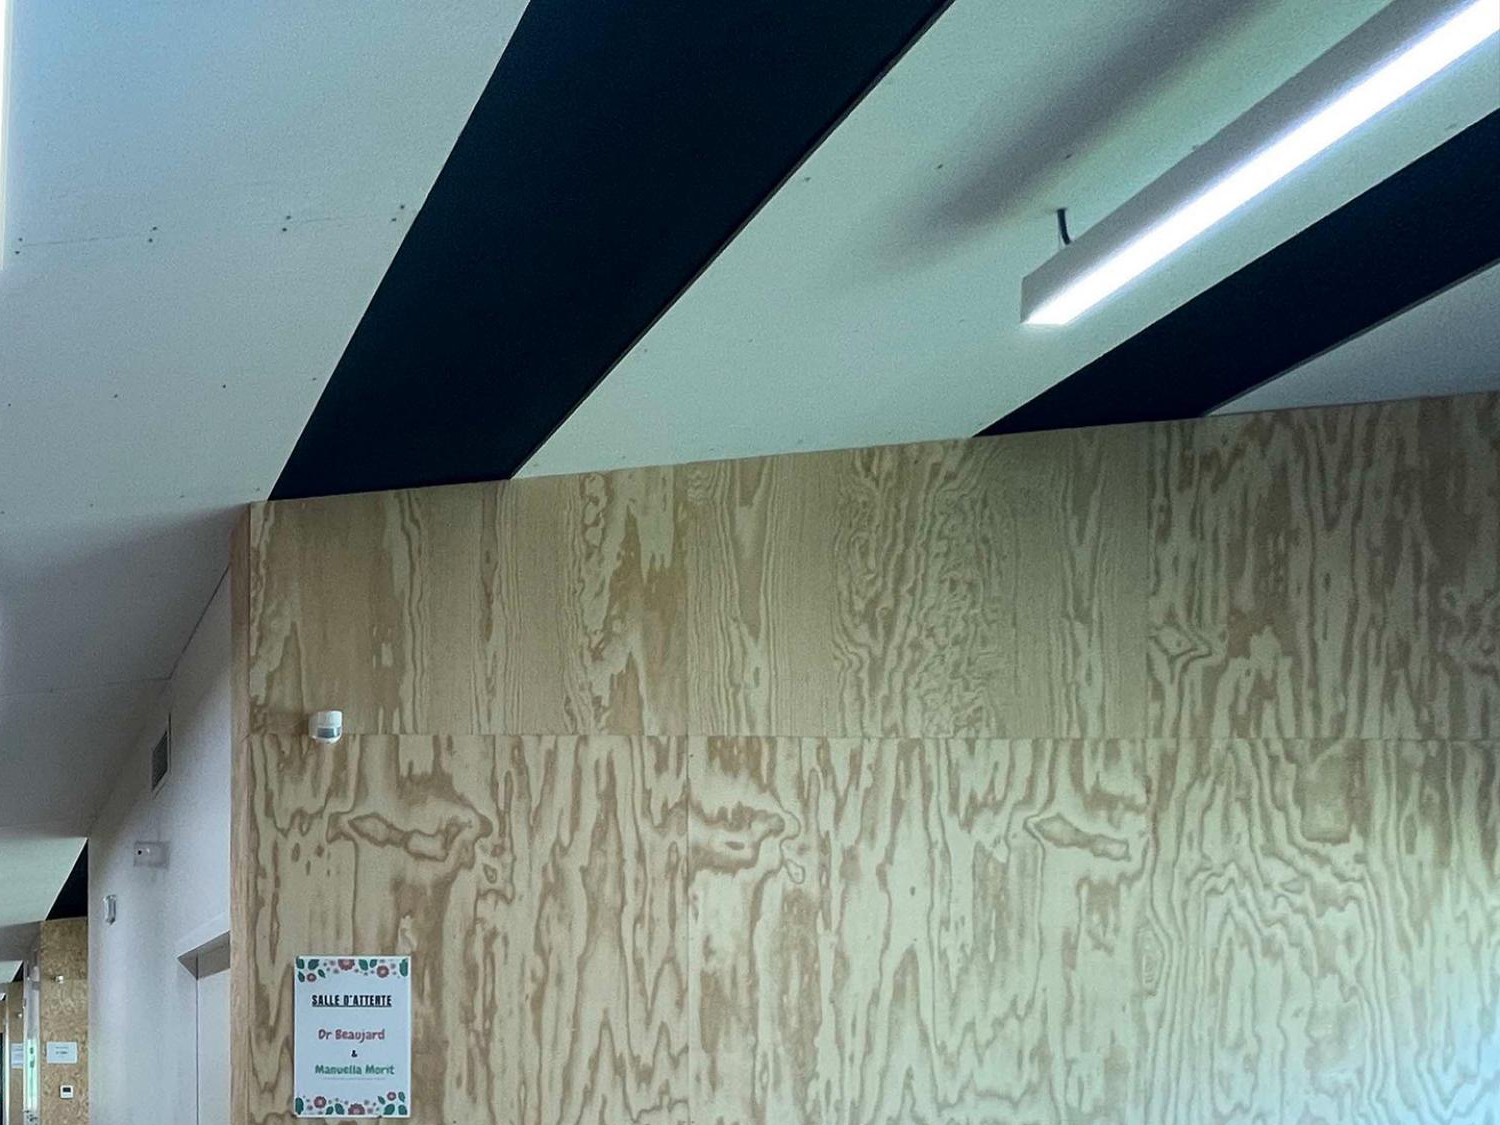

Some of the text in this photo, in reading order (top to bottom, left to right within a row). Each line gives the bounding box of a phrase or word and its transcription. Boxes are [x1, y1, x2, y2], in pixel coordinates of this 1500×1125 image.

[311, 994, 340, 1007] SALLE
[318, 1028, 385, 1043] Dr Beaujard
